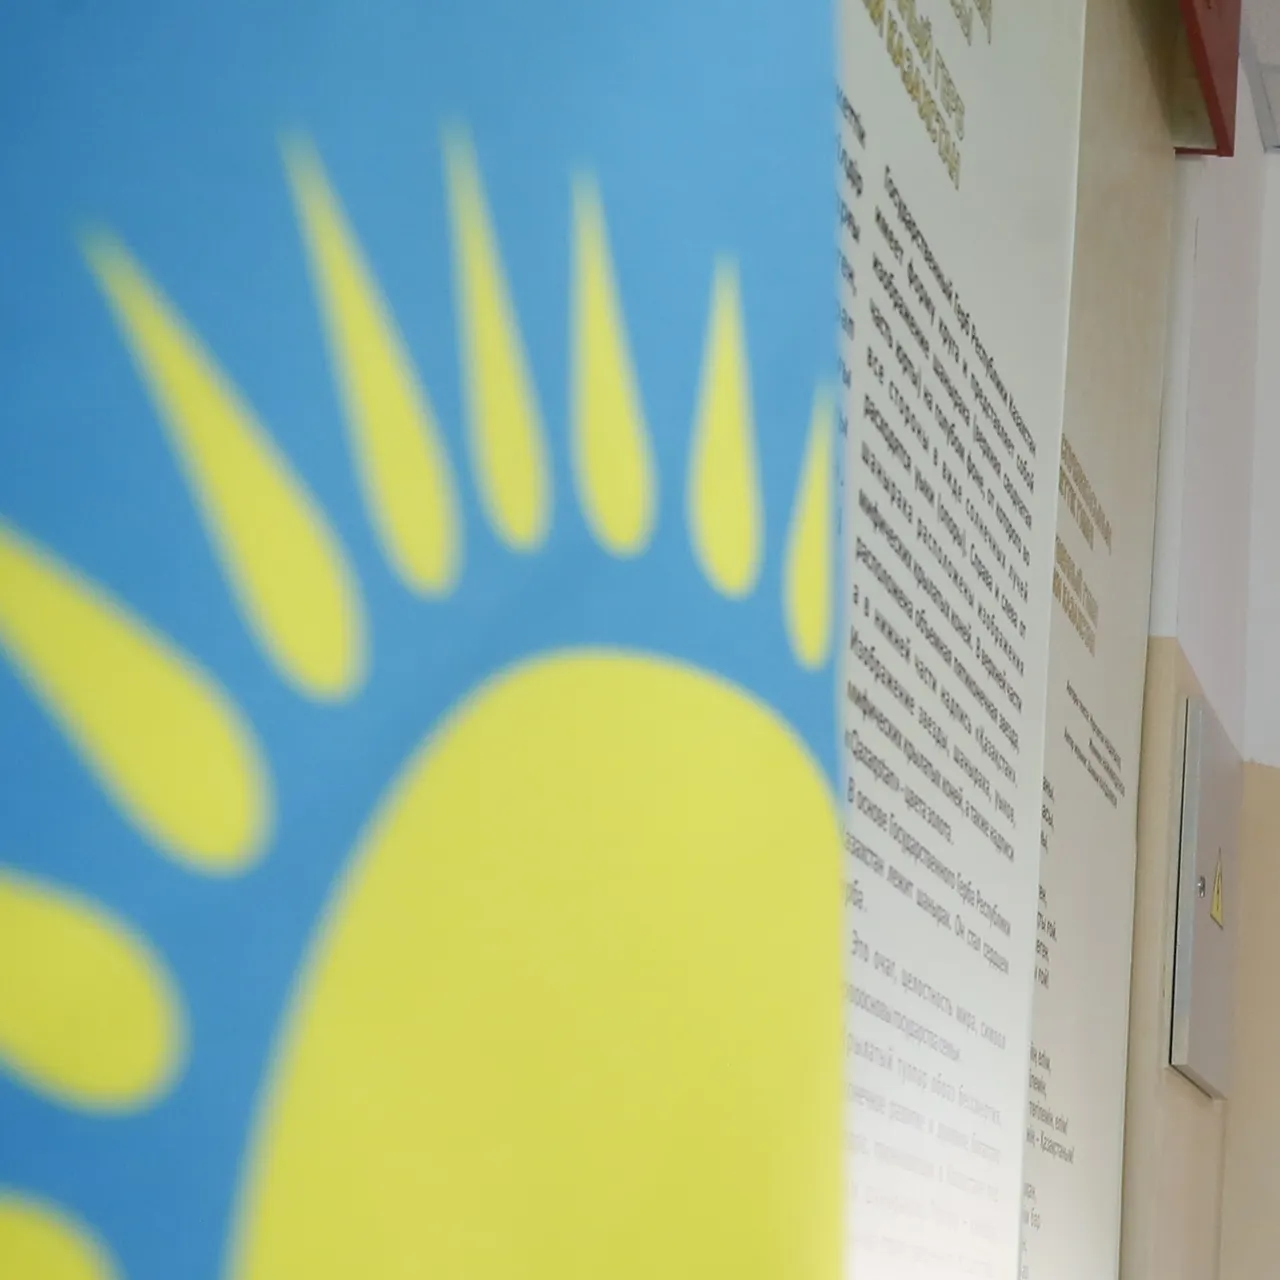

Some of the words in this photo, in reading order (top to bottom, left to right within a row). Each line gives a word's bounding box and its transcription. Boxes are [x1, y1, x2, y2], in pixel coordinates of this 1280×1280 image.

[861, 442, 912, 522] шанырака
[916, 518, 974, 607] расположены
[977, 603, 1023, 676] изображения
